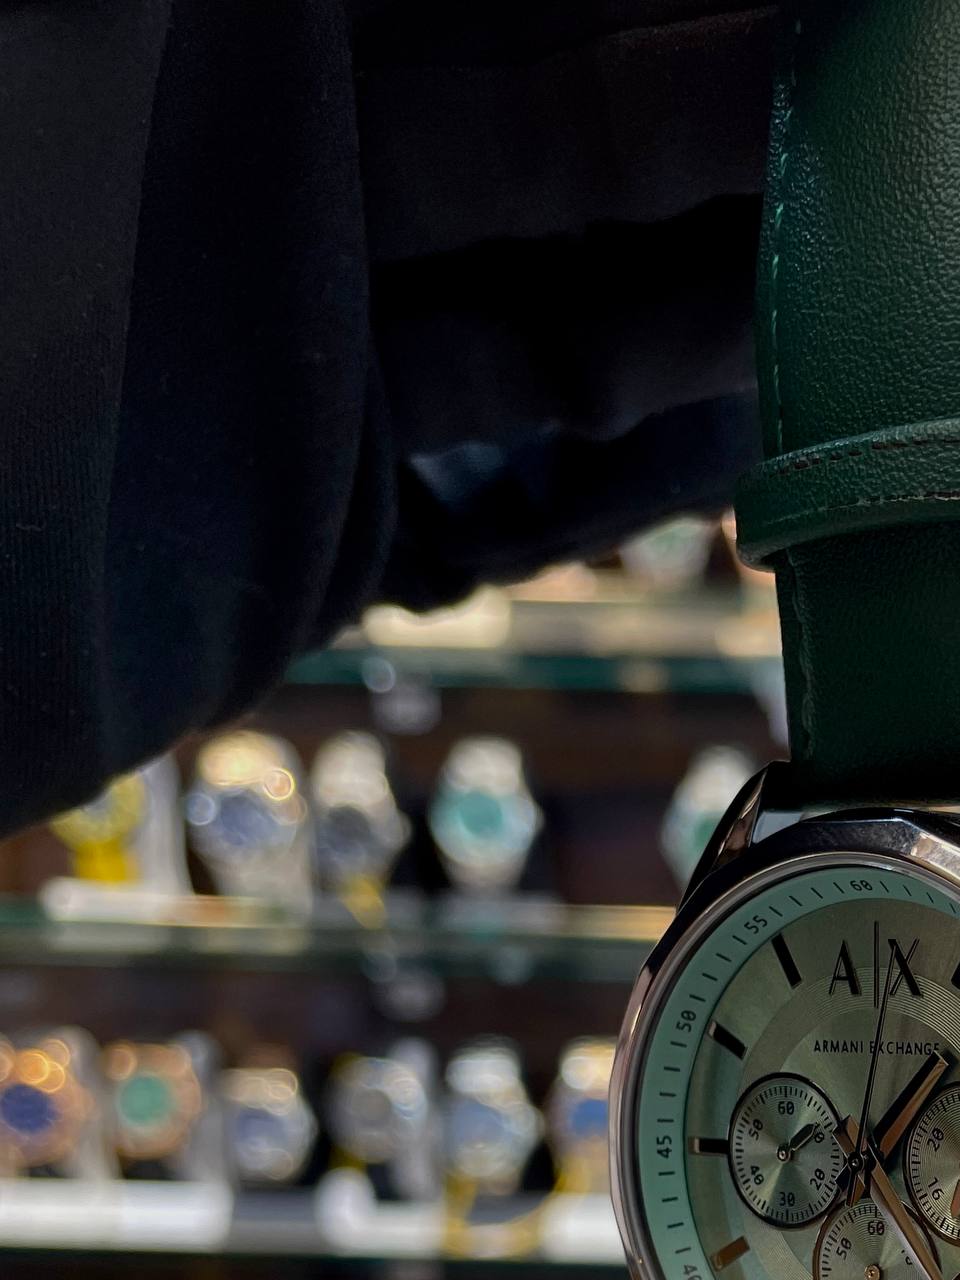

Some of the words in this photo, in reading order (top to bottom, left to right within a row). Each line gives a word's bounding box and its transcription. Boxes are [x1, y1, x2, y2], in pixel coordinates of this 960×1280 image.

[850, 879, 874, 892] 60
[743, 916, 769, 935] 55
[675, 1009, 697, 1033] 50
[813, 1039, 864, 1054] ARMANI
[869, 1040, 940, 1057] EXCHANGE
[777, 1100, 795, 1115] 60
[748, 1118, 764, 1141] 50
[926, 1127, 945, 1152] 20
[656, 1135, 672, 1159] 45
[750, 1164, 765, 1186] 40
[809, 1167, 826, 1191] 20
[778, 1191, 796, 1207] 30
[927, 1177, 945, 1201] 16
[867, 1220, 885, 1236] 60
[836, 1236, 853, 1261] 50
